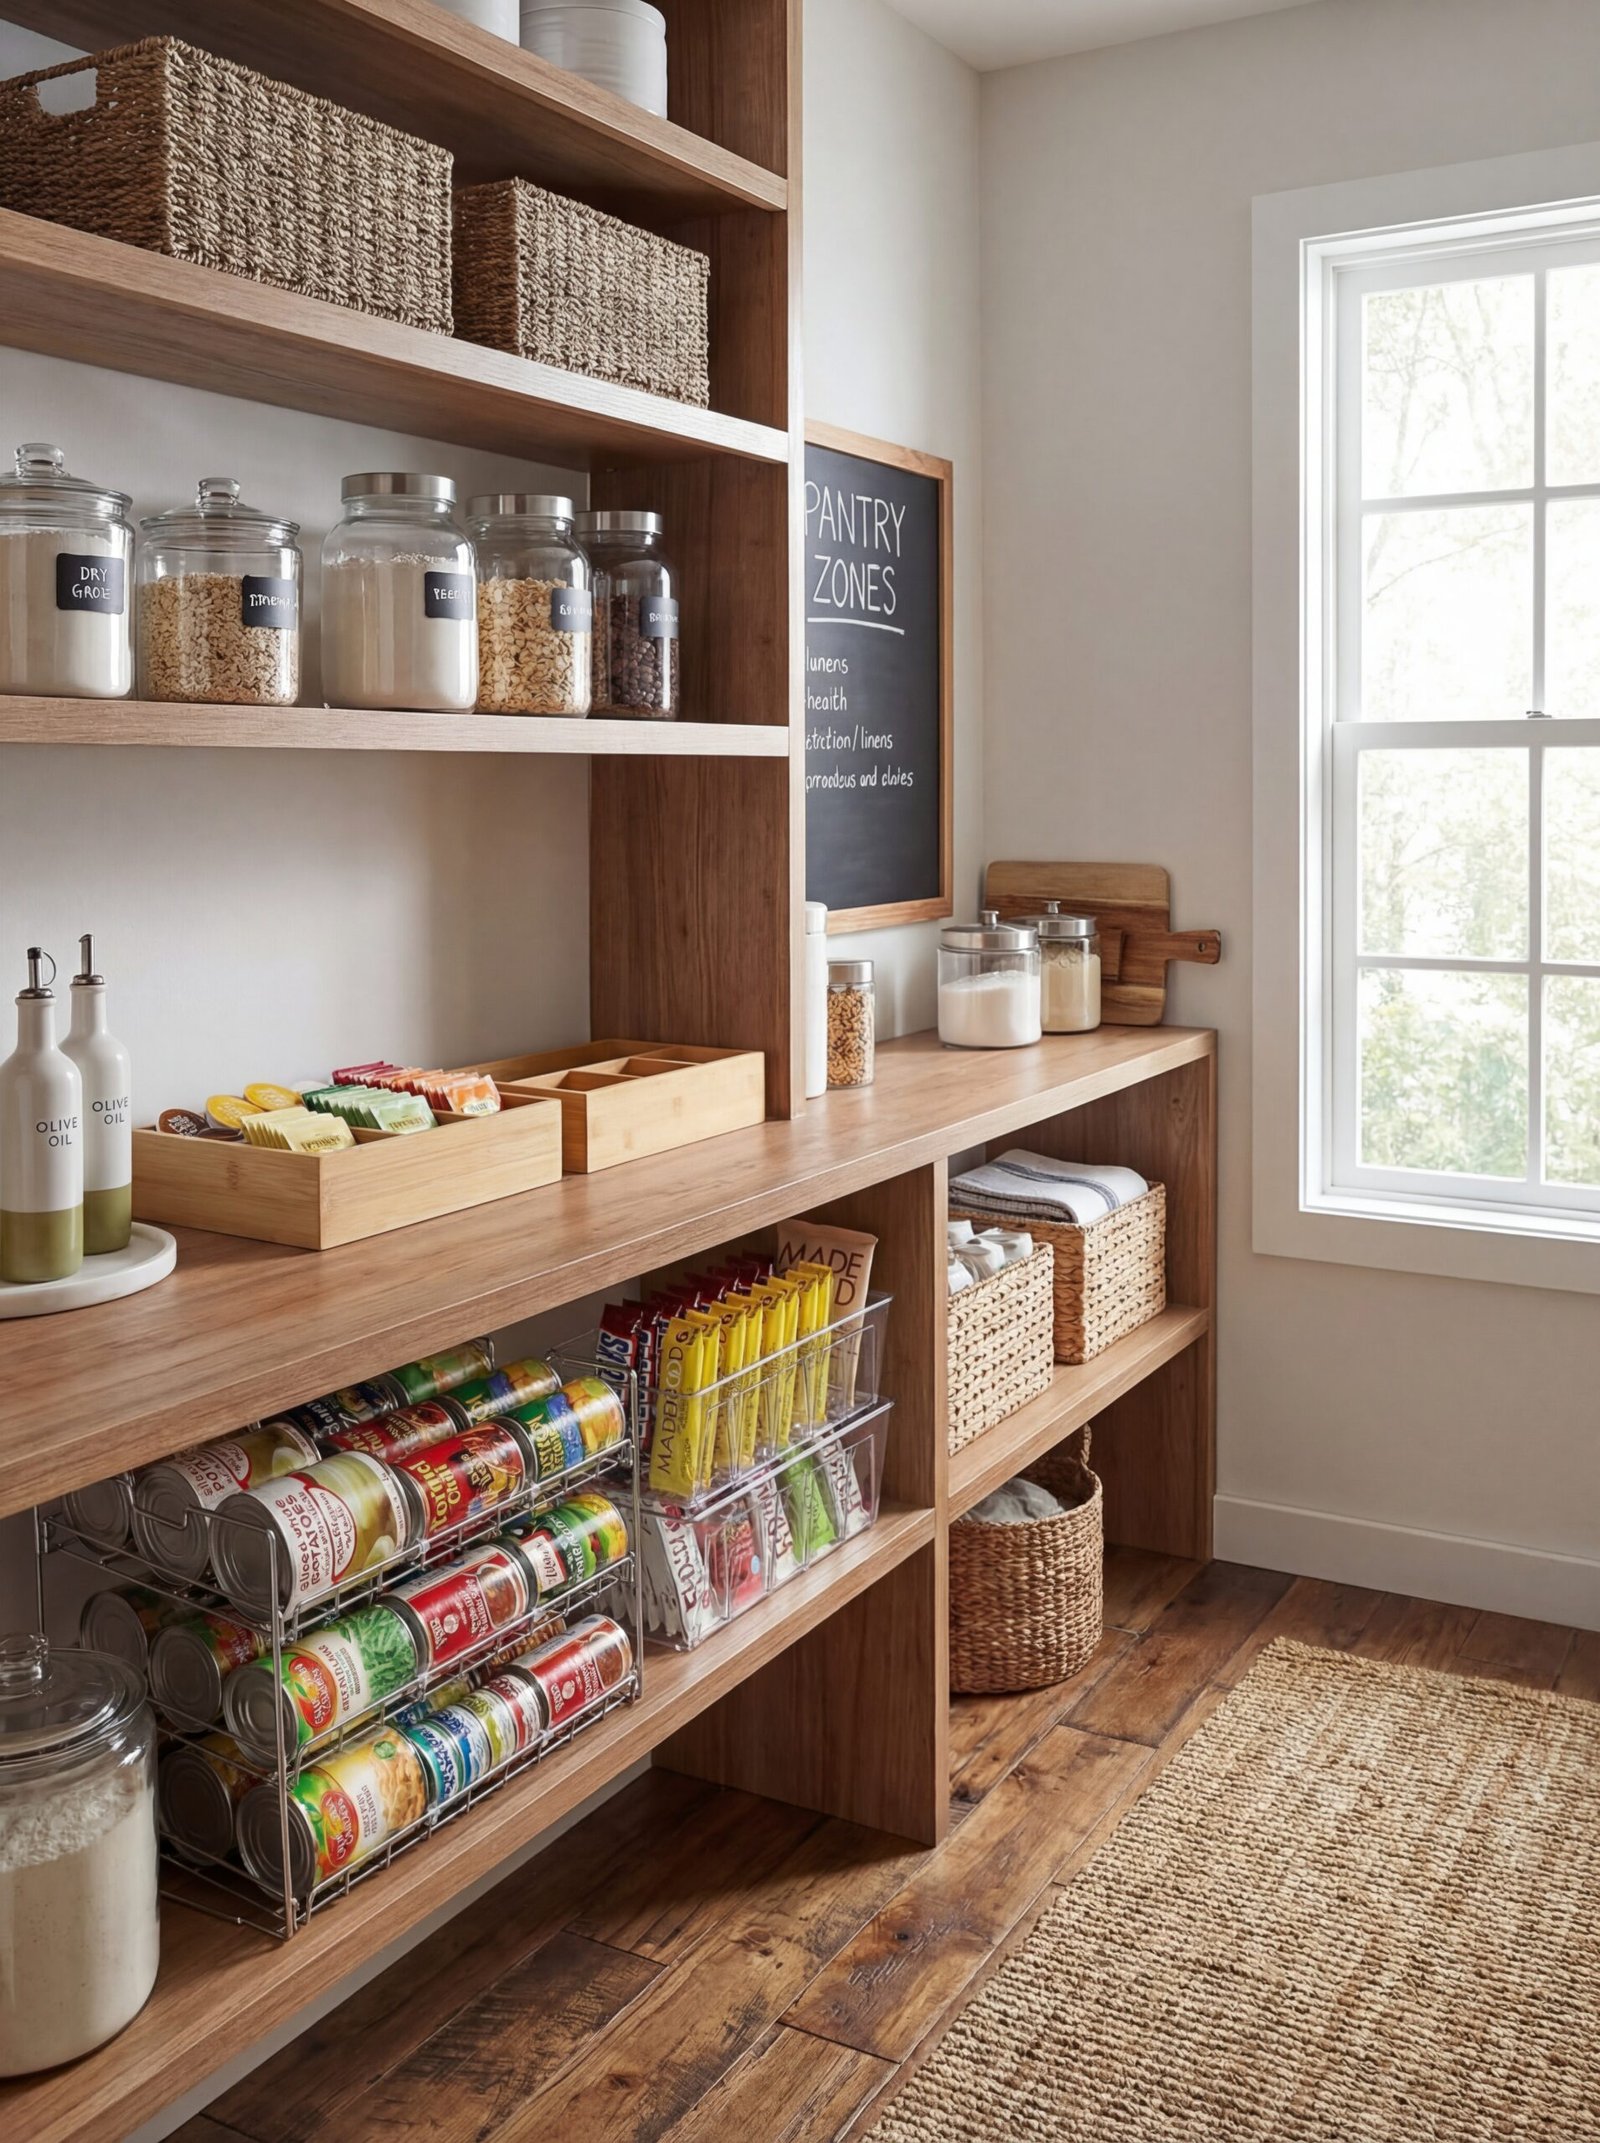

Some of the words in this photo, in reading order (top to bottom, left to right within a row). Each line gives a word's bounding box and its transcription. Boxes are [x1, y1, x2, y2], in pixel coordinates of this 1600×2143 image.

[804, 481, 906, 558] PANTRY
[80, 566, 109, 583] DRY
[813, 554, 897, 615] ZONES
[860, 765, 878, 787] and
[92, 1096, 128, 1112] OLIVE
[36, 1116, 78, 1133] OLIVE
[104, 1113, 125, 1125] OIL
[48, 1134, 72, 1147] OIL
[777, 1241, 865, 1279] MADE
